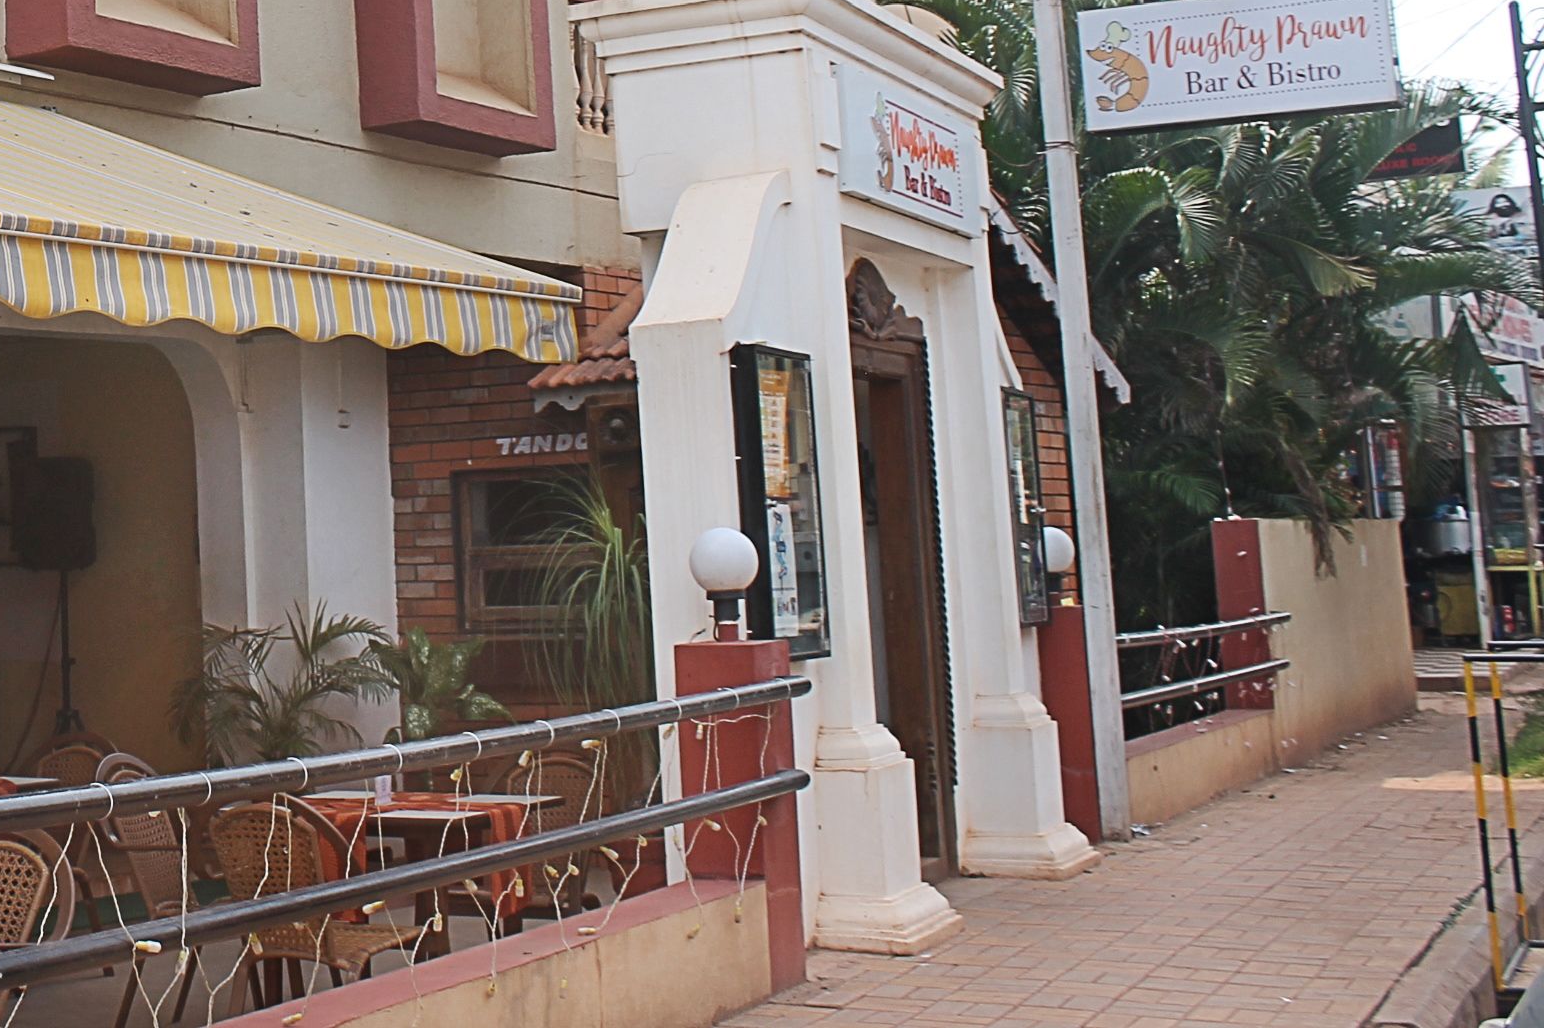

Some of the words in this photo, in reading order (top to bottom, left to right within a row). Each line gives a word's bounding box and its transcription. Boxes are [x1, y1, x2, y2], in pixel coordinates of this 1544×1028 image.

[1144, 16, 1273, 69] Naughty
[1276, 13, 1370, 54] Prawn
[1185, 70, 1229, 95] Bar
[1236, 64, 1258, 90] &
[1266, 61, 1342, 87] Bistro
